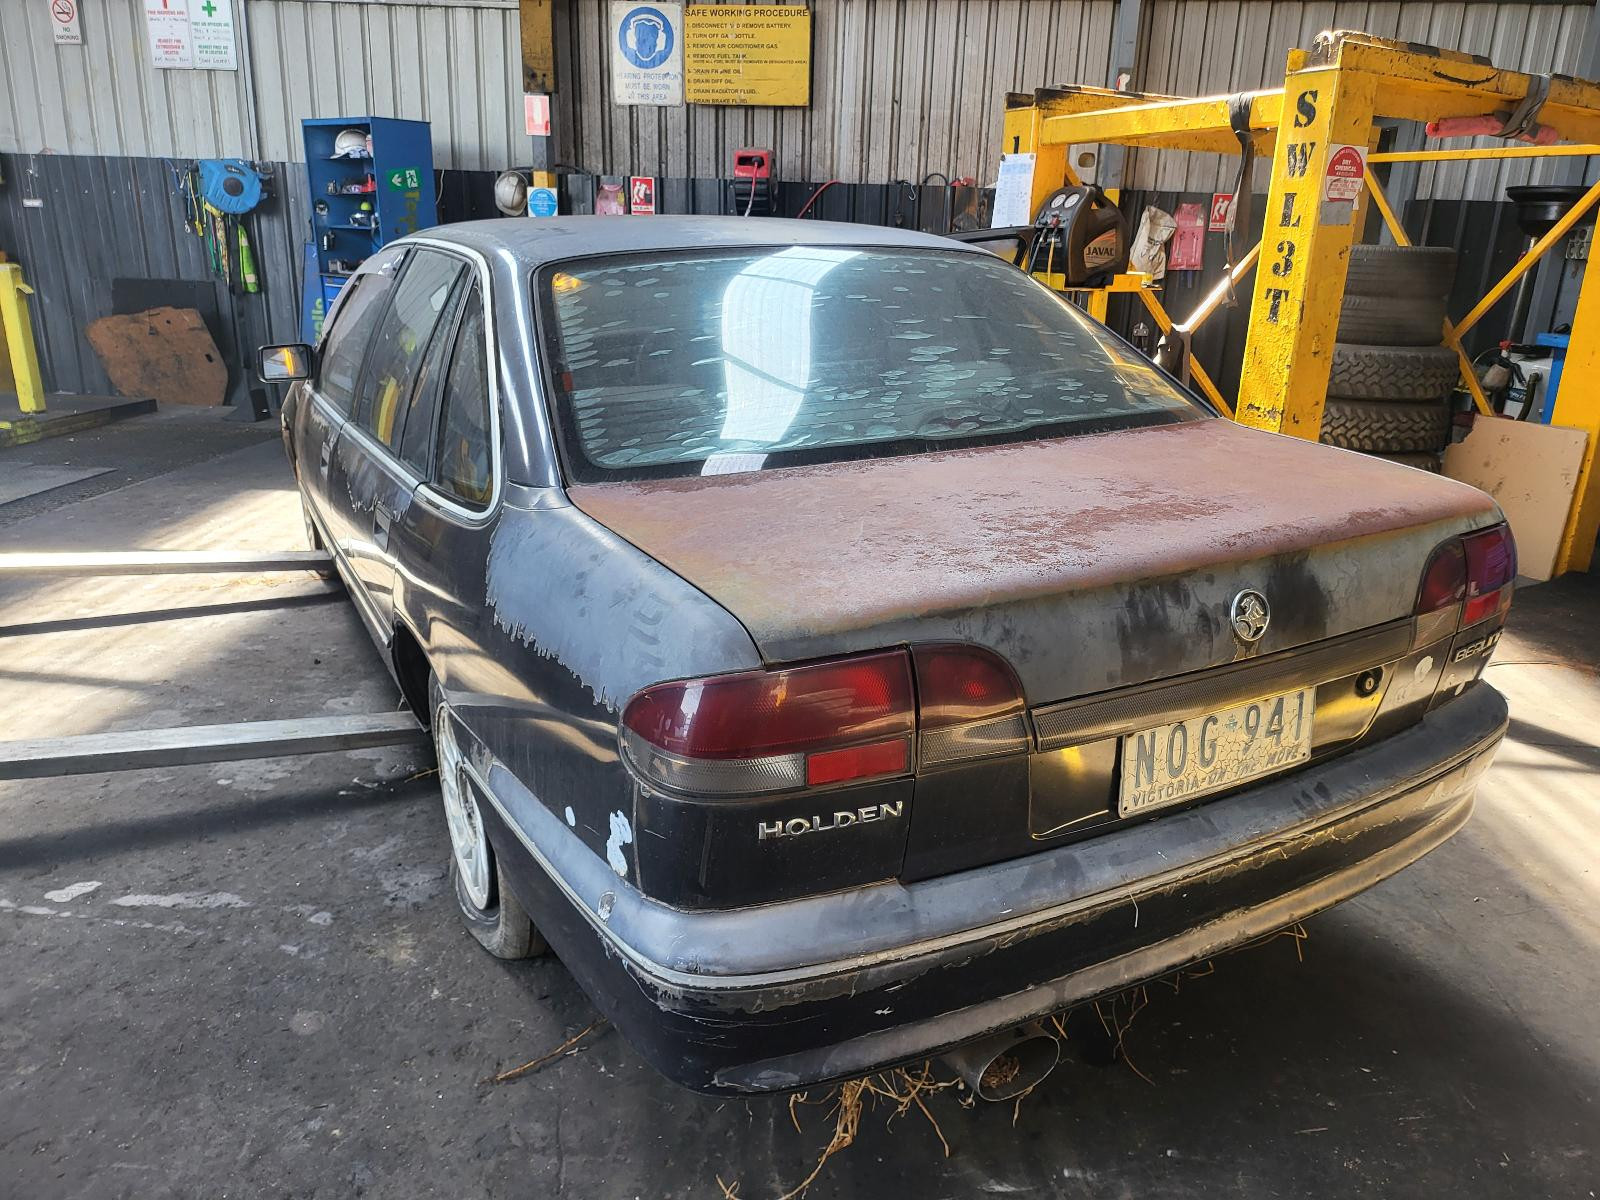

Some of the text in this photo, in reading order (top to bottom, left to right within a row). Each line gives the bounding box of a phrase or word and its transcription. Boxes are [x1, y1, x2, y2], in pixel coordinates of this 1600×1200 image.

[684, 9, 808, 17] SAFE WORKING PROCEDURE
[1134, 691, 1305, 788] NOG 941
[758, 801, 903, 840] HOLDEN
